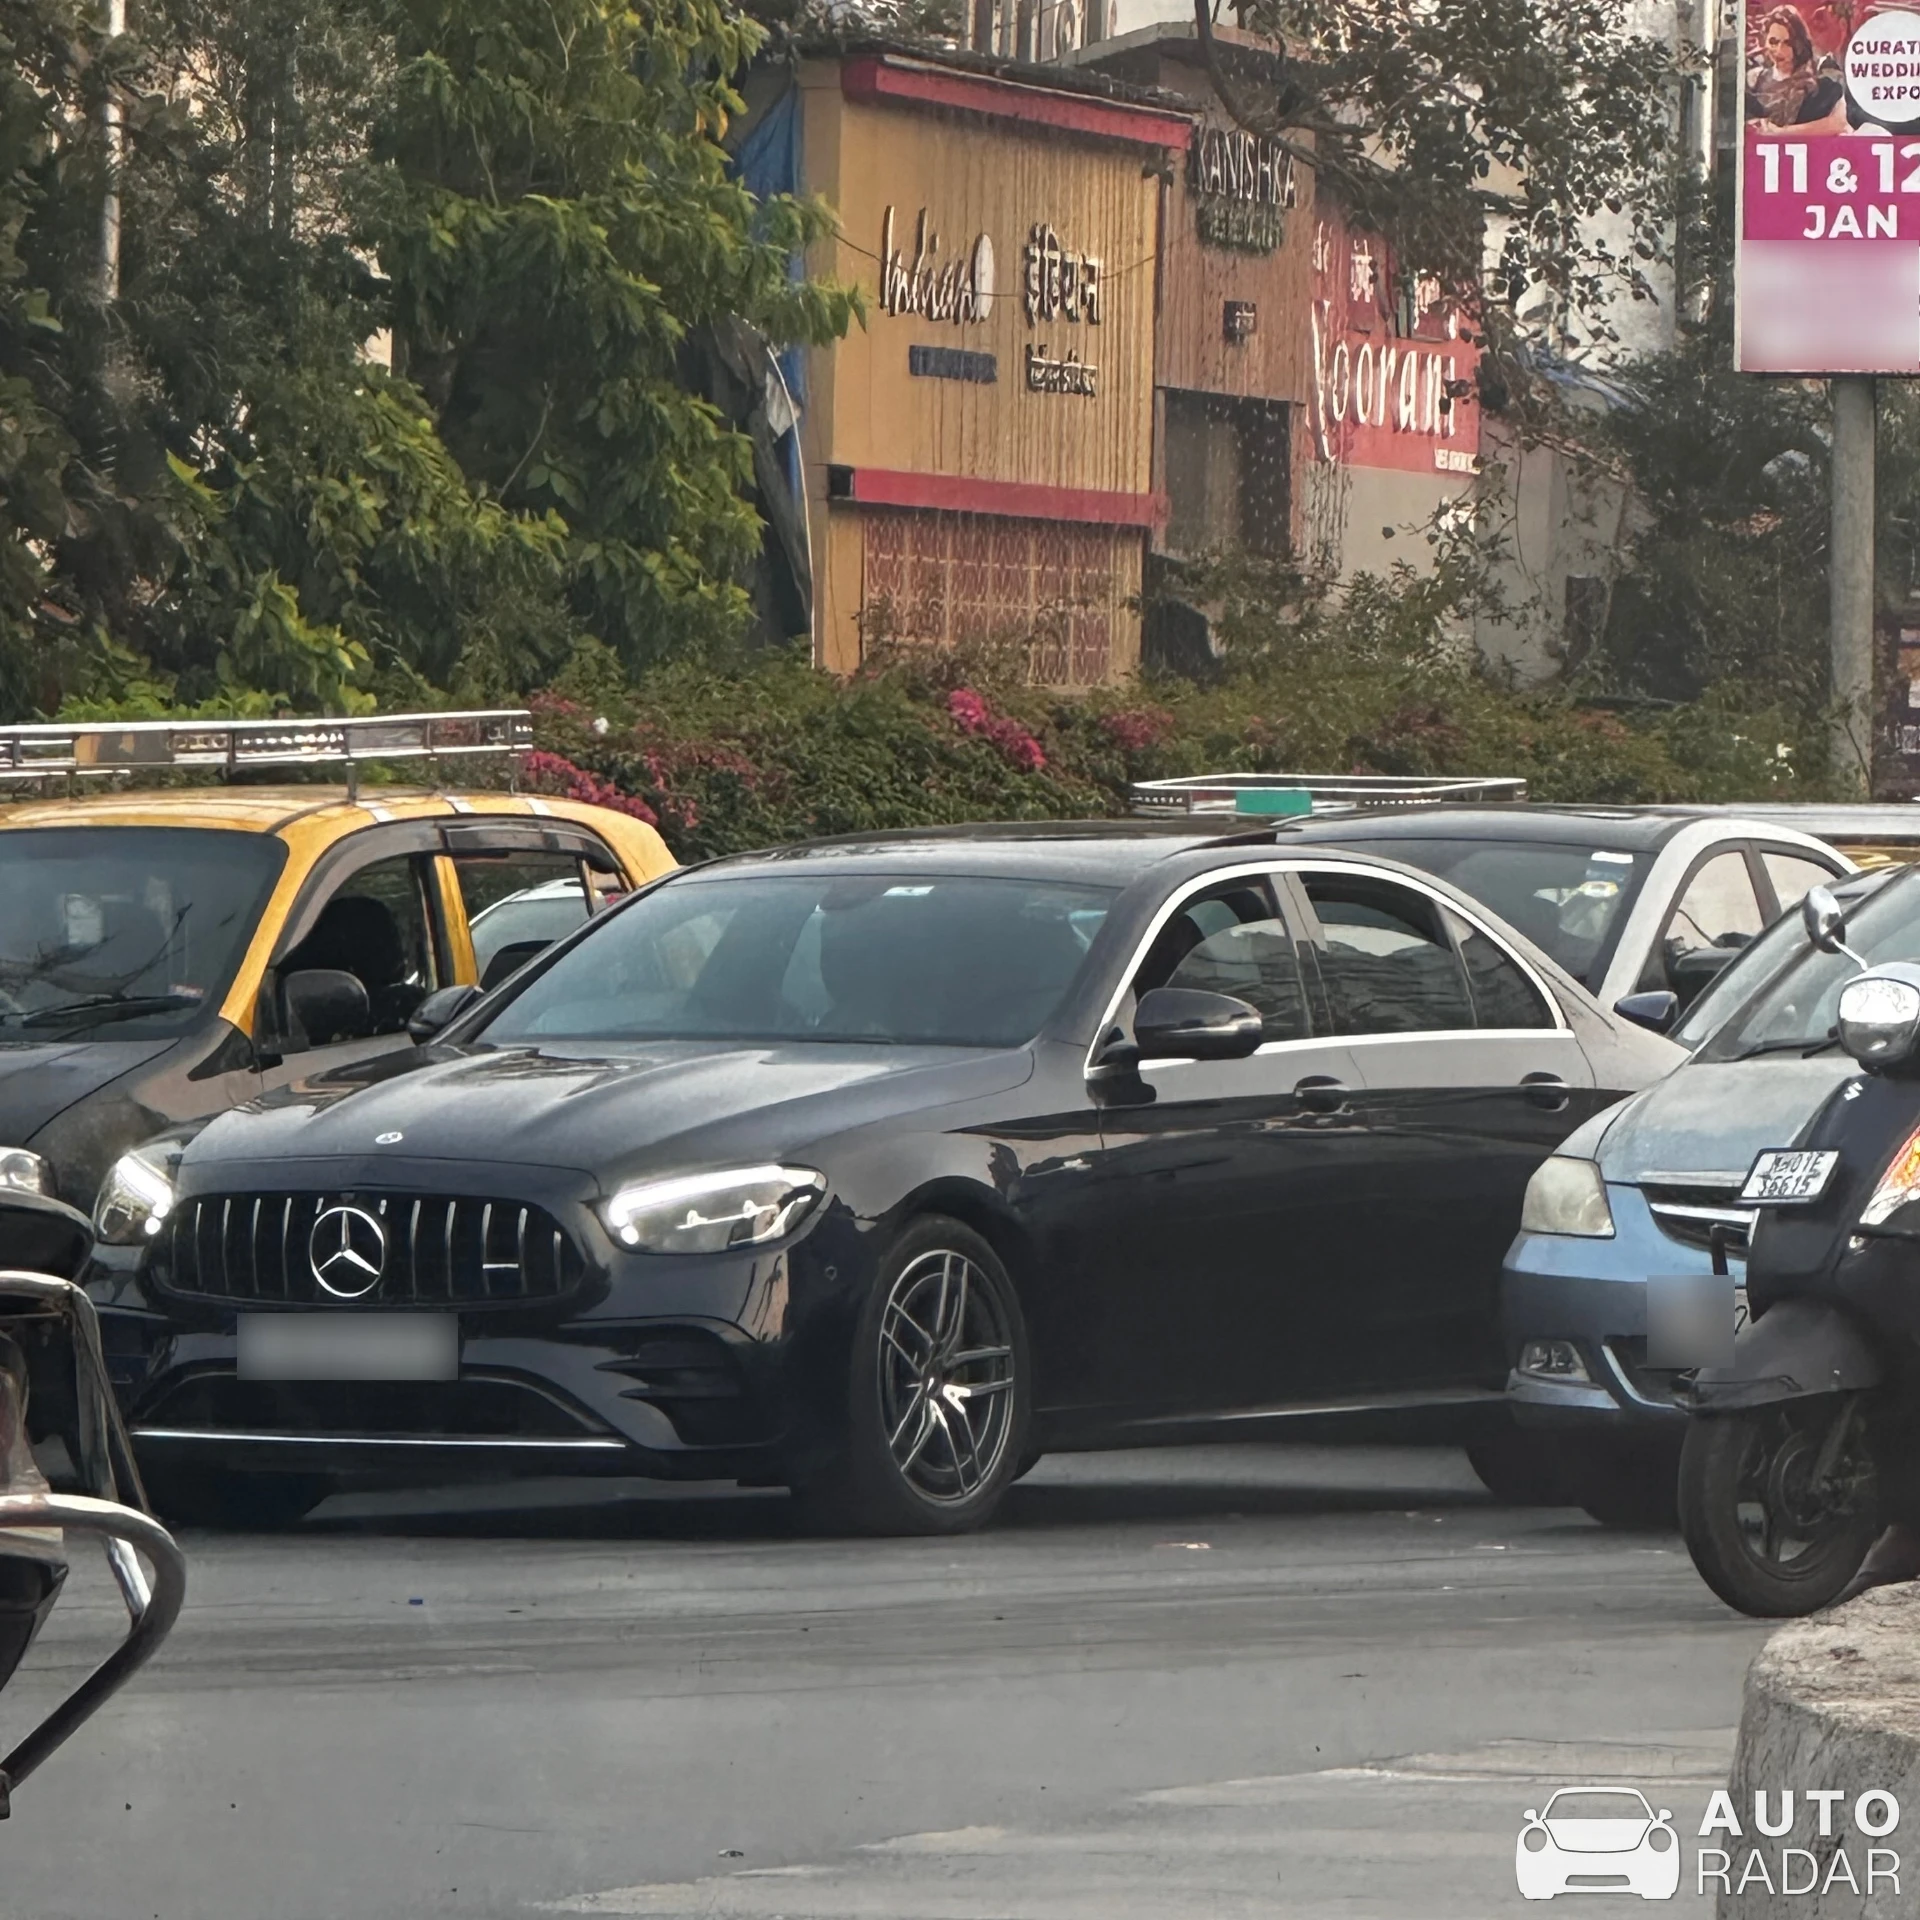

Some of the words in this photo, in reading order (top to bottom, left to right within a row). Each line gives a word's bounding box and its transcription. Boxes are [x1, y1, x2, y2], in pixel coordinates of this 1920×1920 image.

[1851, 40, 1920, 55] CURAT
[1871, 86, 1920, 100] EXPO
[1756, 143, 1808, 193] 11
[1826, 157, 1858, 194] &
[1871, 142, 1920, 193] 12
[1803, 204, 1898, 239] JAN
